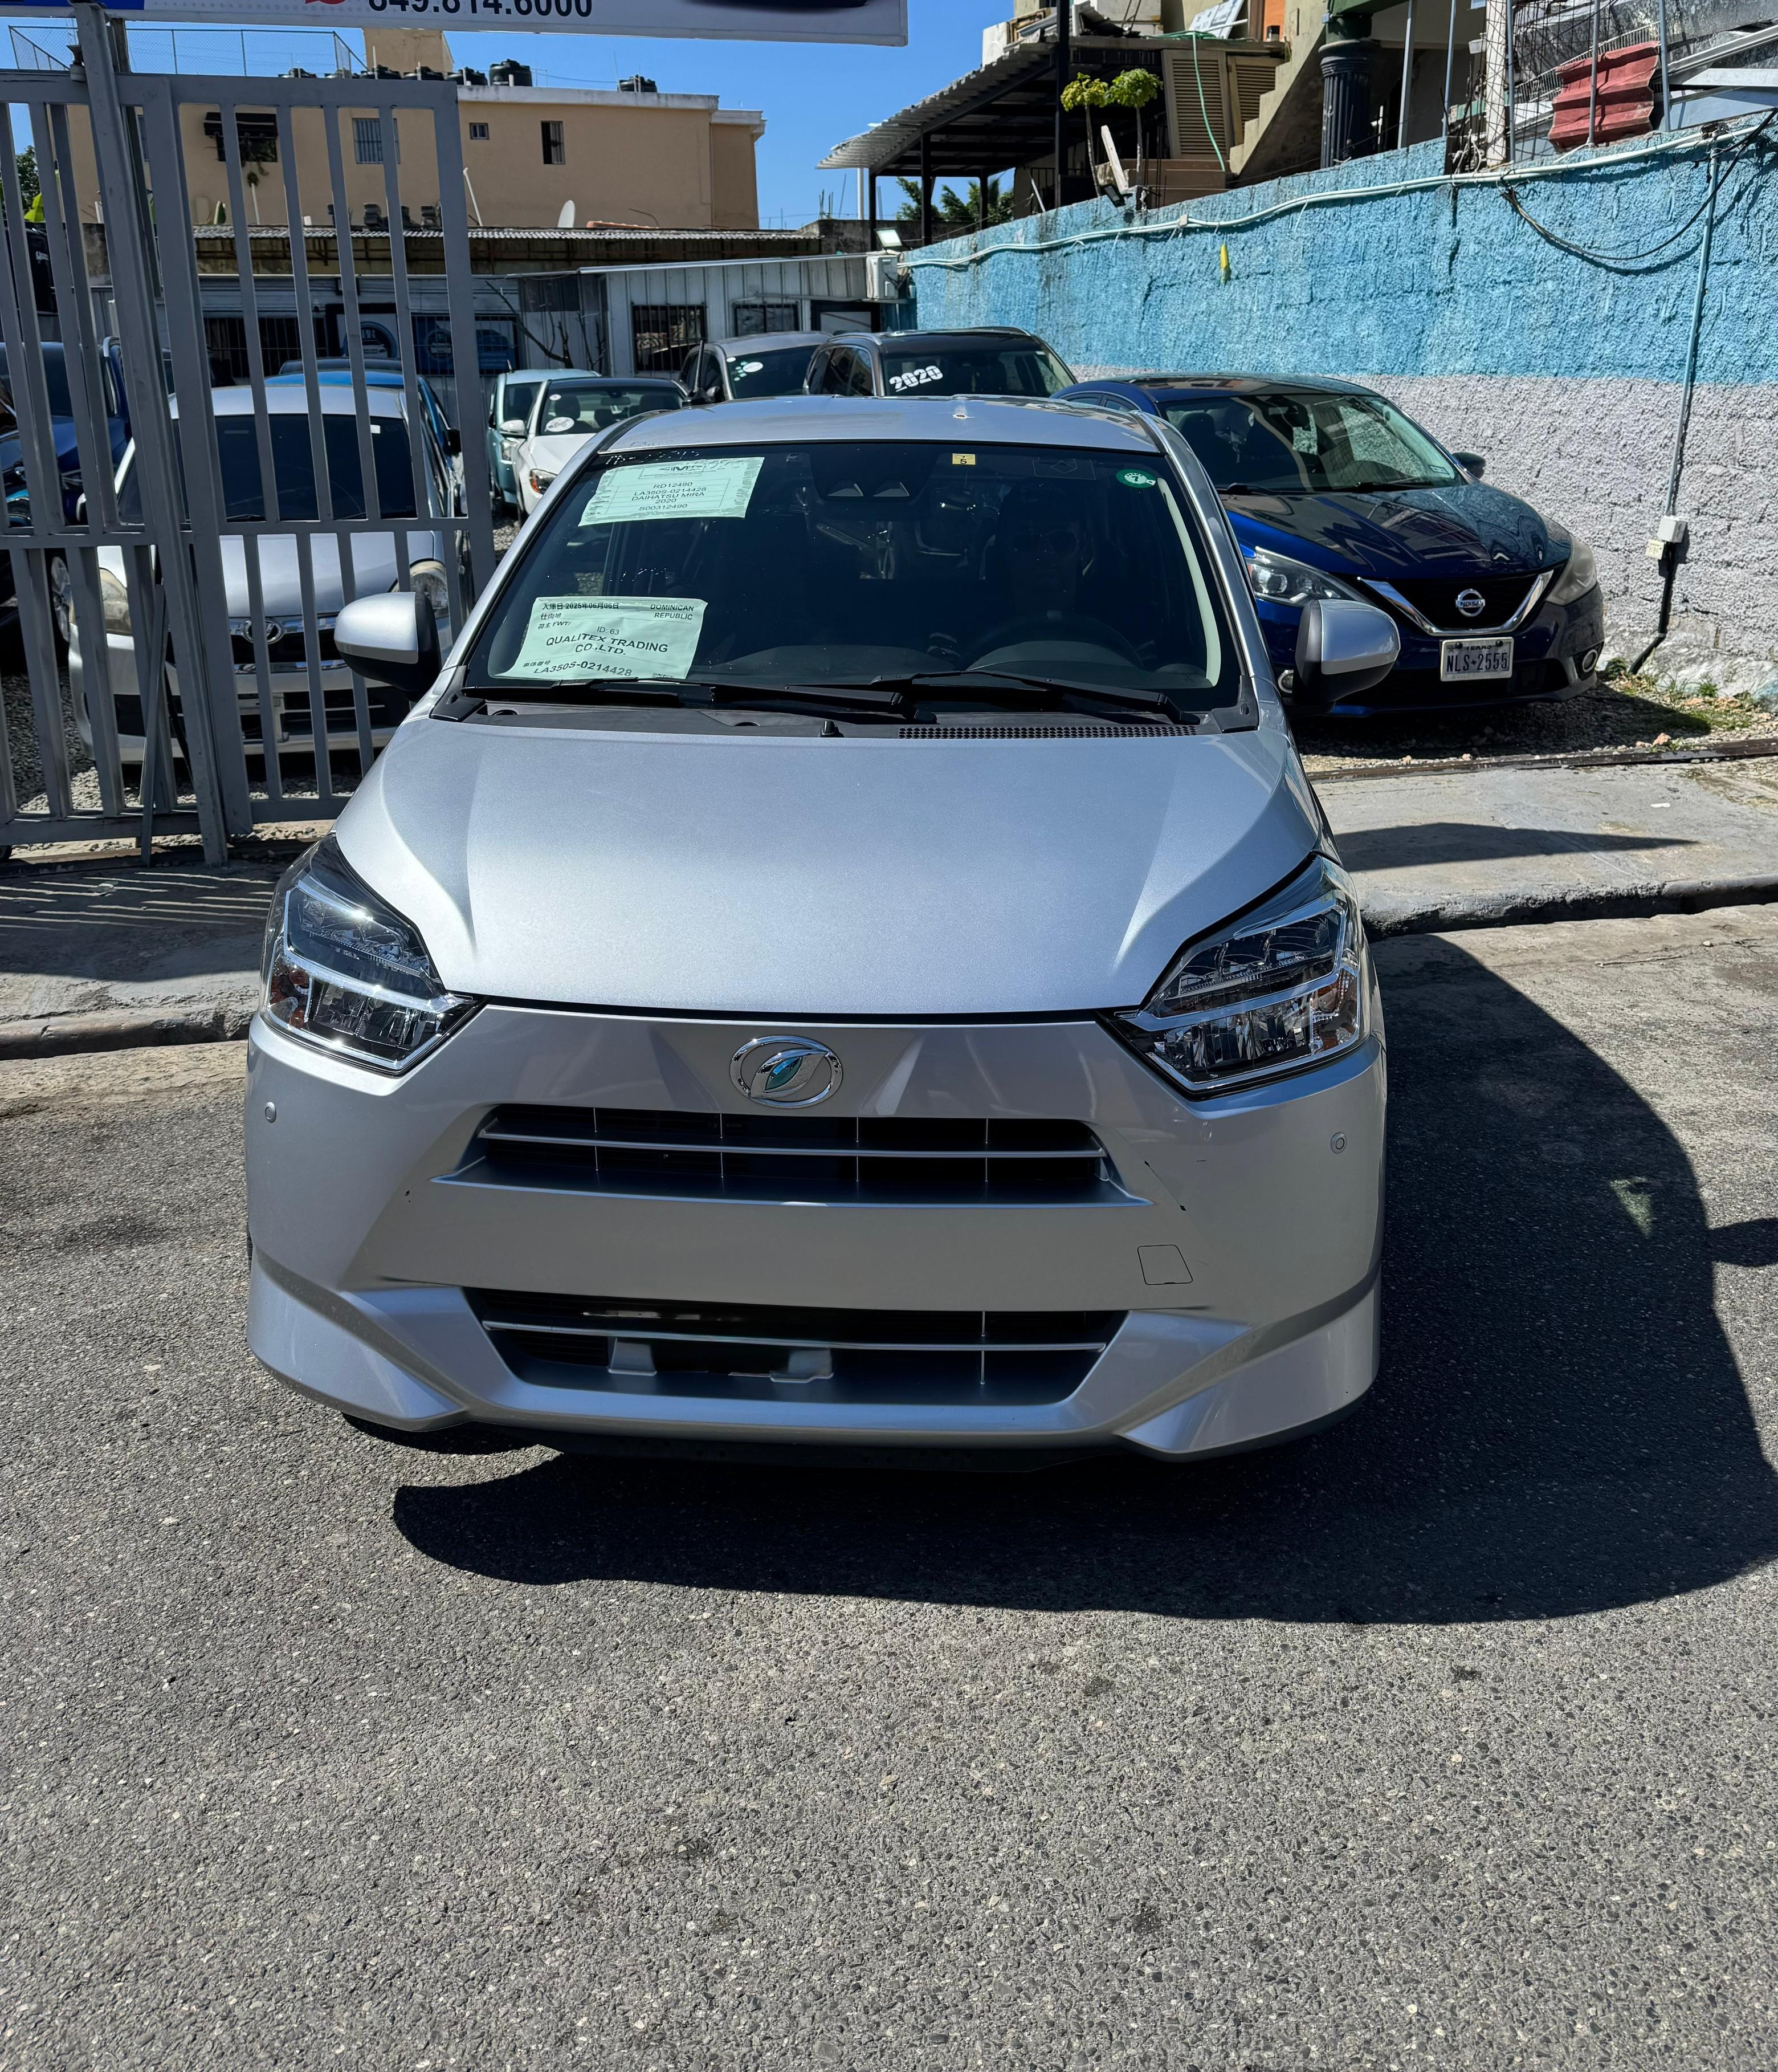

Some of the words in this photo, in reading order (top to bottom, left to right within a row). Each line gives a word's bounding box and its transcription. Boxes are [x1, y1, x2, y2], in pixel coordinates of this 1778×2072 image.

[889, 365, 943, 392] 2020
[546, 633, 607, 646] QUALITEX
[610, 637, 668, 653] TRADING
[575, 643, 626, 655] CO.,LTD.
[533, 661, 633, 677] LA350S-0214428
